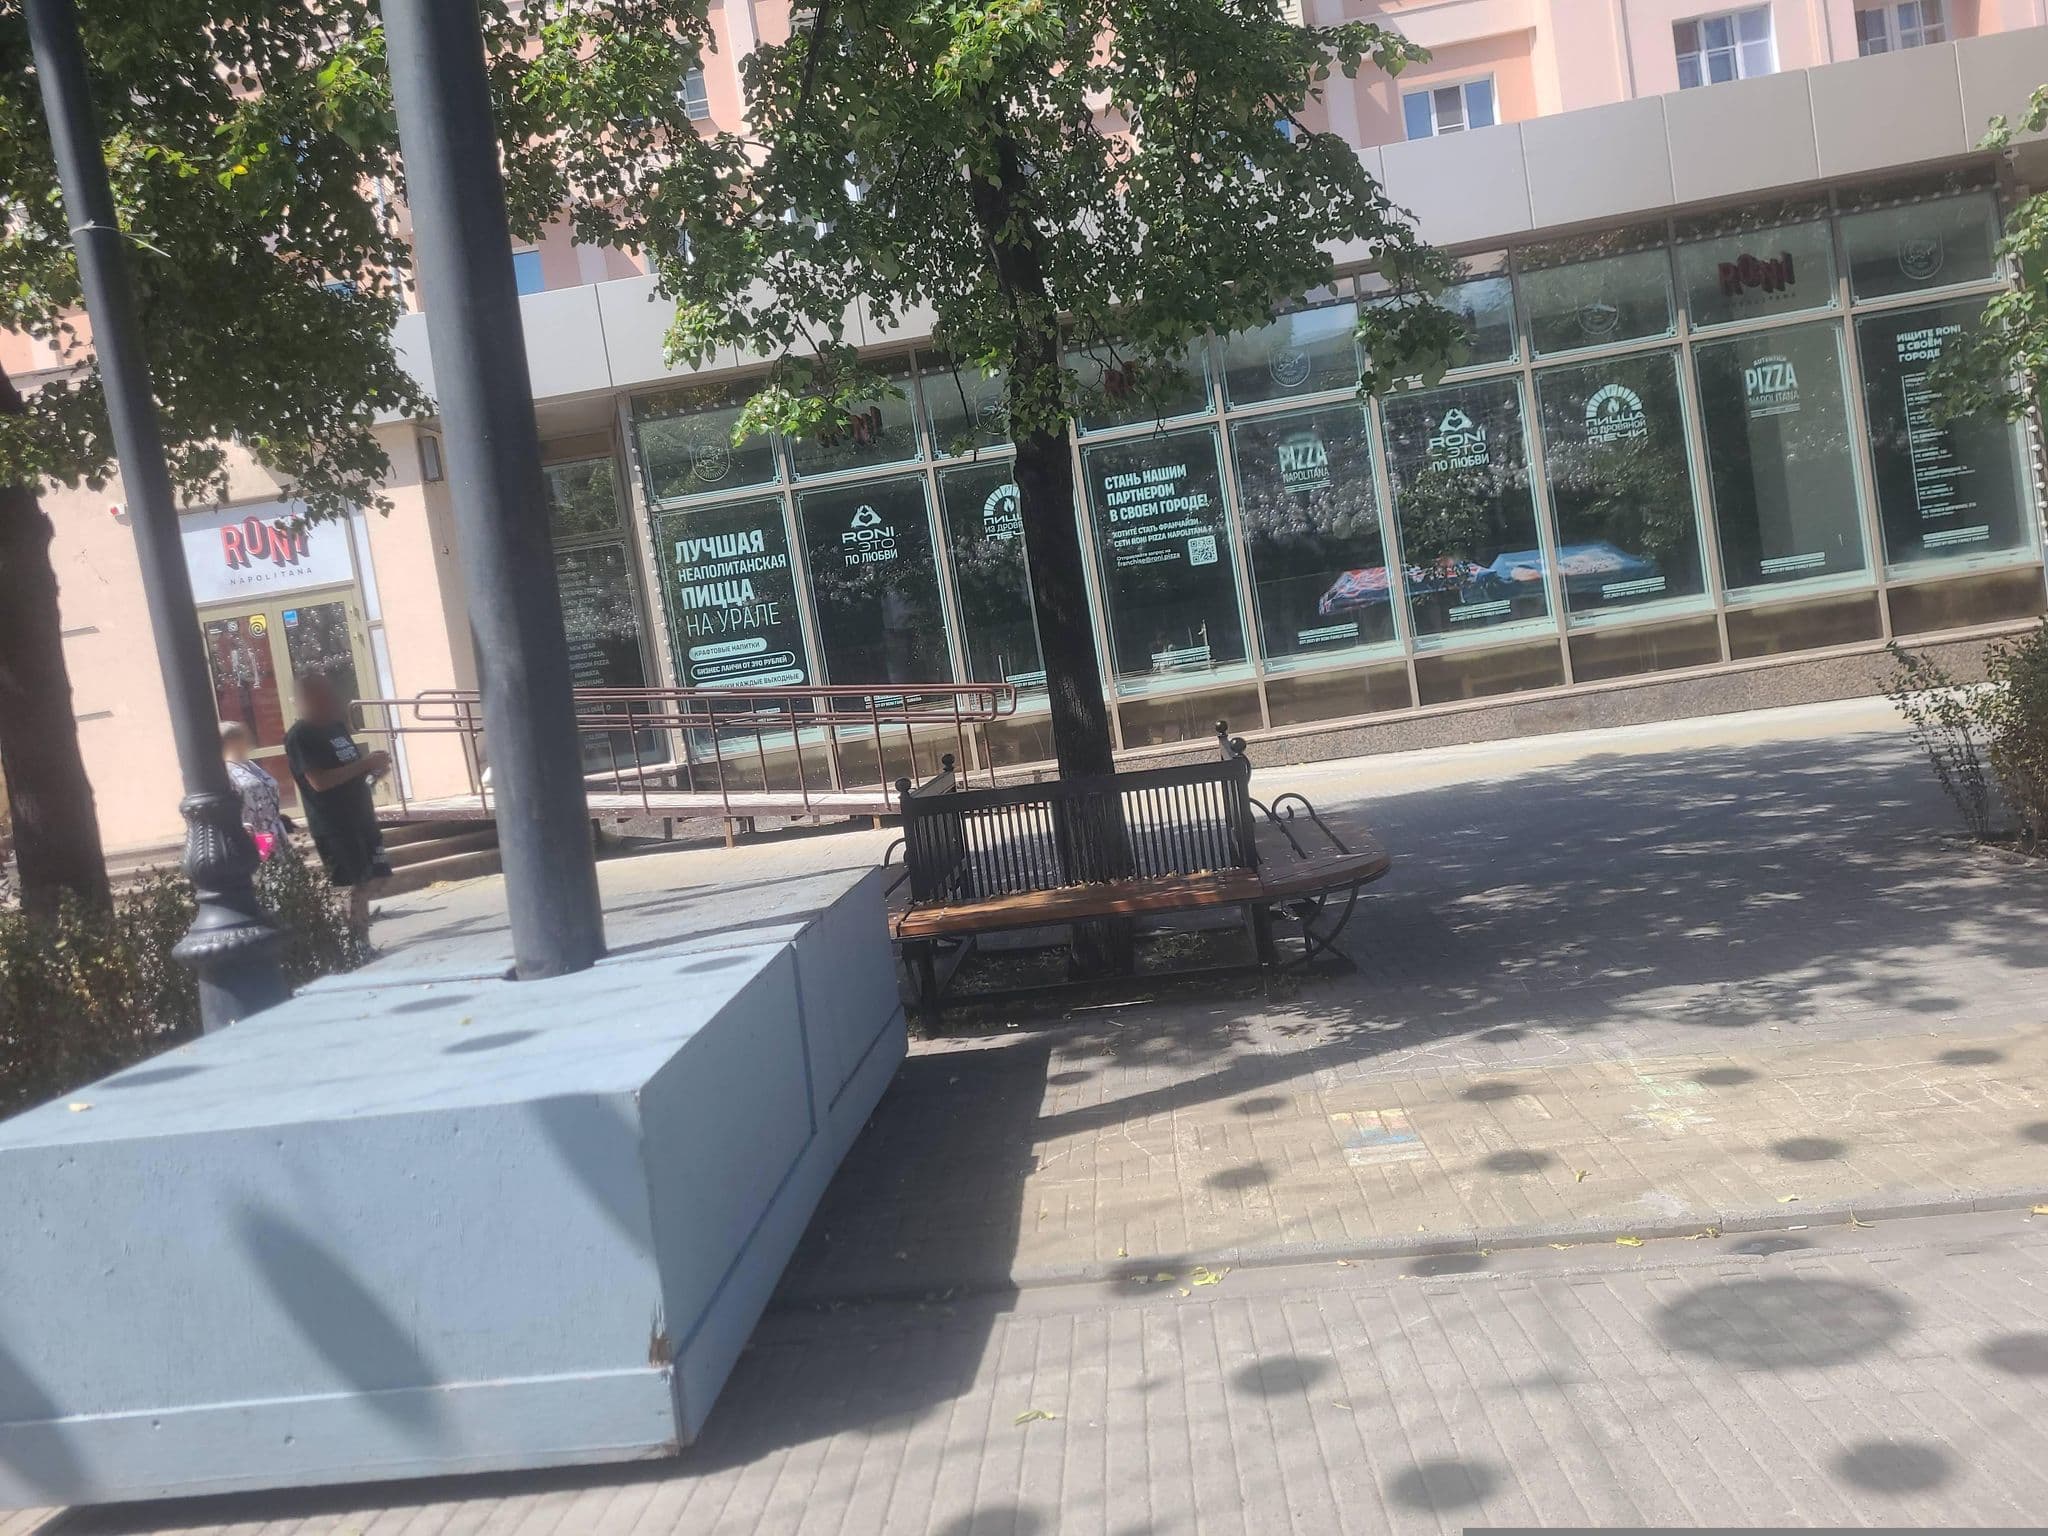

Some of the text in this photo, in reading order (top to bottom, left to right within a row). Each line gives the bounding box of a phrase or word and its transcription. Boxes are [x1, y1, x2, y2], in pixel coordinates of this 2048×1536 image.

[1897, 325, 1961, 343] ИЩИТЕ RONI
[1897, 343, 1905, 353] В
[1899, 348, 1941, 363] ГОРОДЕ
[1744, 361, 1798, 396] PIZZA
[1428, 429, 1487, 449] RONI
[1278, 441, 1329, 472] PIZZA
[1449, 442, 1487, 458] ЭТО
[1431, 452, 1490, 473] ПО ЛЮБВИ
[1104, 464, 1187, 490] СТАНЬ НАШИМ
[1282, 467, 1330, 483] NAPOLITANA
[1107, 483, 1175, 506] ПАРТНЕРОМ
[1109, 509, 1118, 522] В
[1120, 502, 1159, 521] СВОЕМ
[841, 526, 896, 544] RONI
[985, 525, 996, 534] ИЗ
[986, 530, 1025, 541] ПЕЧ
[1112, 528, 1138, 539] ХОТИТЕ
[1138, 525, 1158, 534] СТАТЬ
[675, 529, 765, 564] ЛУЧШАЯ
[858, 538, 896, 553] ЭТО
[844, 549, 899, 568] ПО ЛЮБВИ
[230, 567, 312, 585] NAPOLITANA
[678, 553, 787, 583] НЕАПОЛИТАНСКАЯ
[681, 579, 756, 610] ПИЦЦА
[686, 602, 782, 638] НА УРАЛЕ
[694, 641, 760, 657] КРАФТОВЫЕ НАПИТКИ
[764, 655, 788, 667] РУБЛЕЙ
